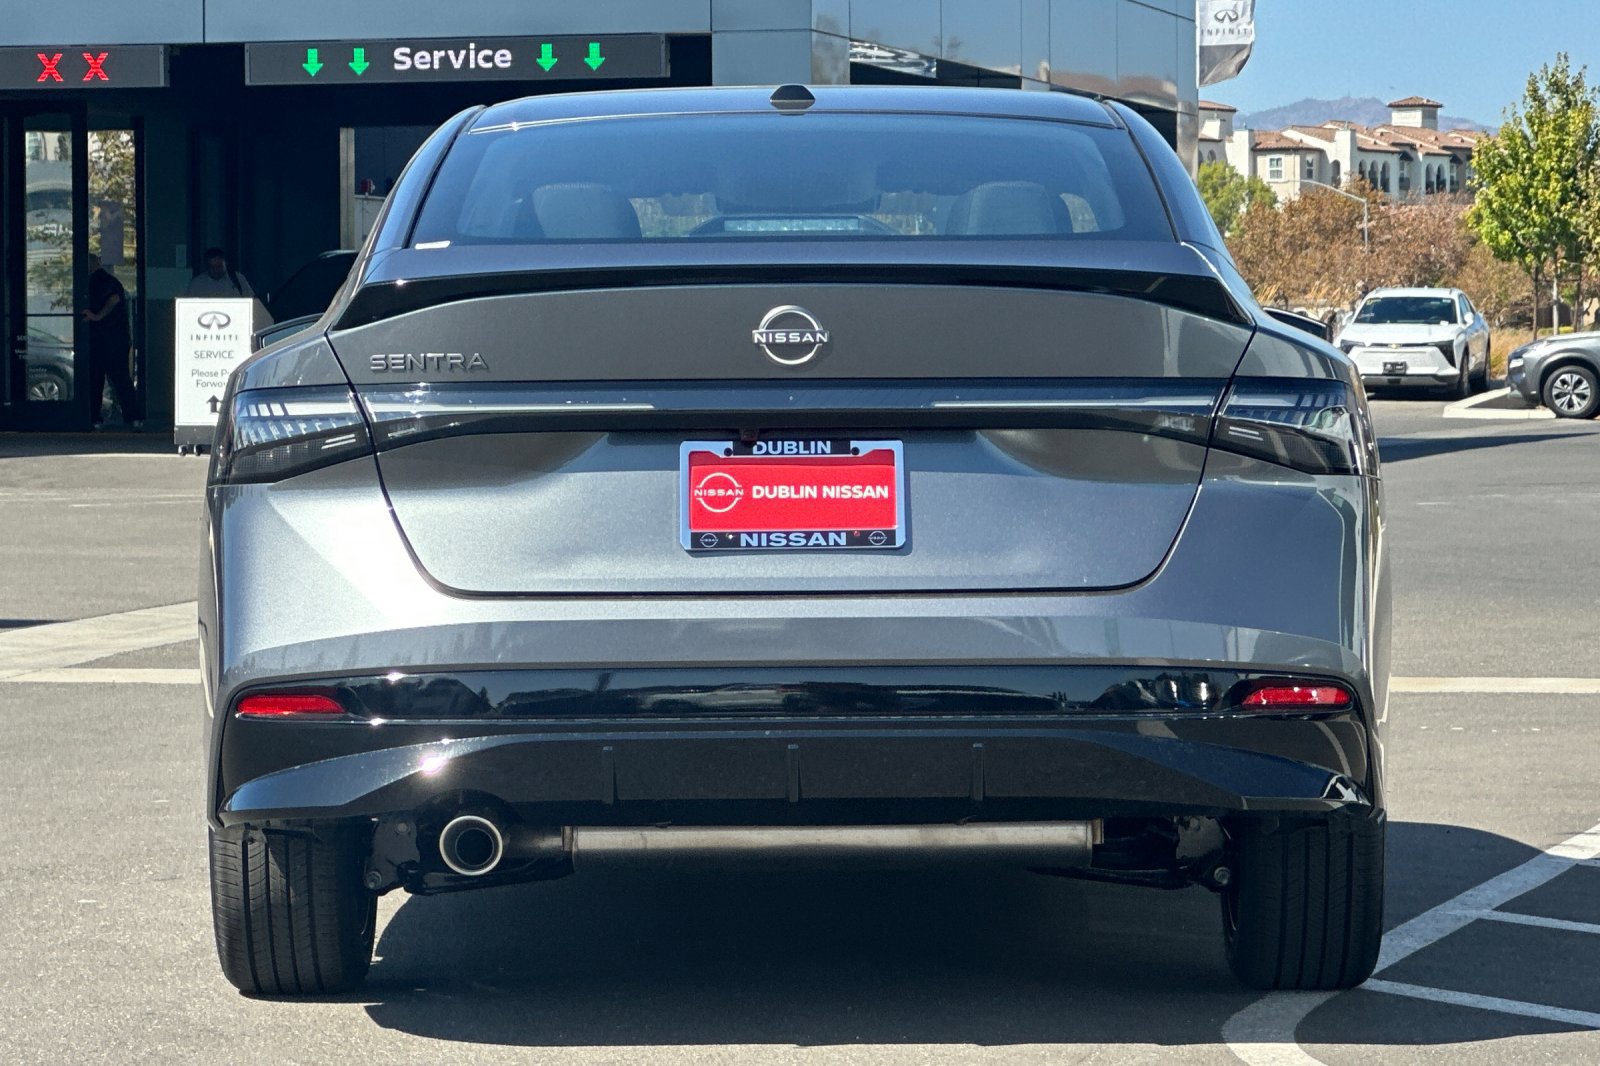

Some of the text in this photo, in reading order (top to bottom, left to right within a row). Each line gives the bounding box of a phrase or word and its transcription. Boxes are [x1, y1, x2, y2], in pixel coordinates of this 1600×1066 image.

[393, 42, 512, 71] Service
[190, 333, 238, 341] INFINITI
[753, 332, 828, 343] NISSAN
[194, 350, 234, 359] SERVICE
[370, 353, 488, 370] SENTRA
[191, 369, 218, 378] Please
[752, 441, 831, 455] DUBLIN
[694, 485, 888, 499] NISSAN DUBLIN NISSAN
[740, 532, 847, 547] NISSAN
